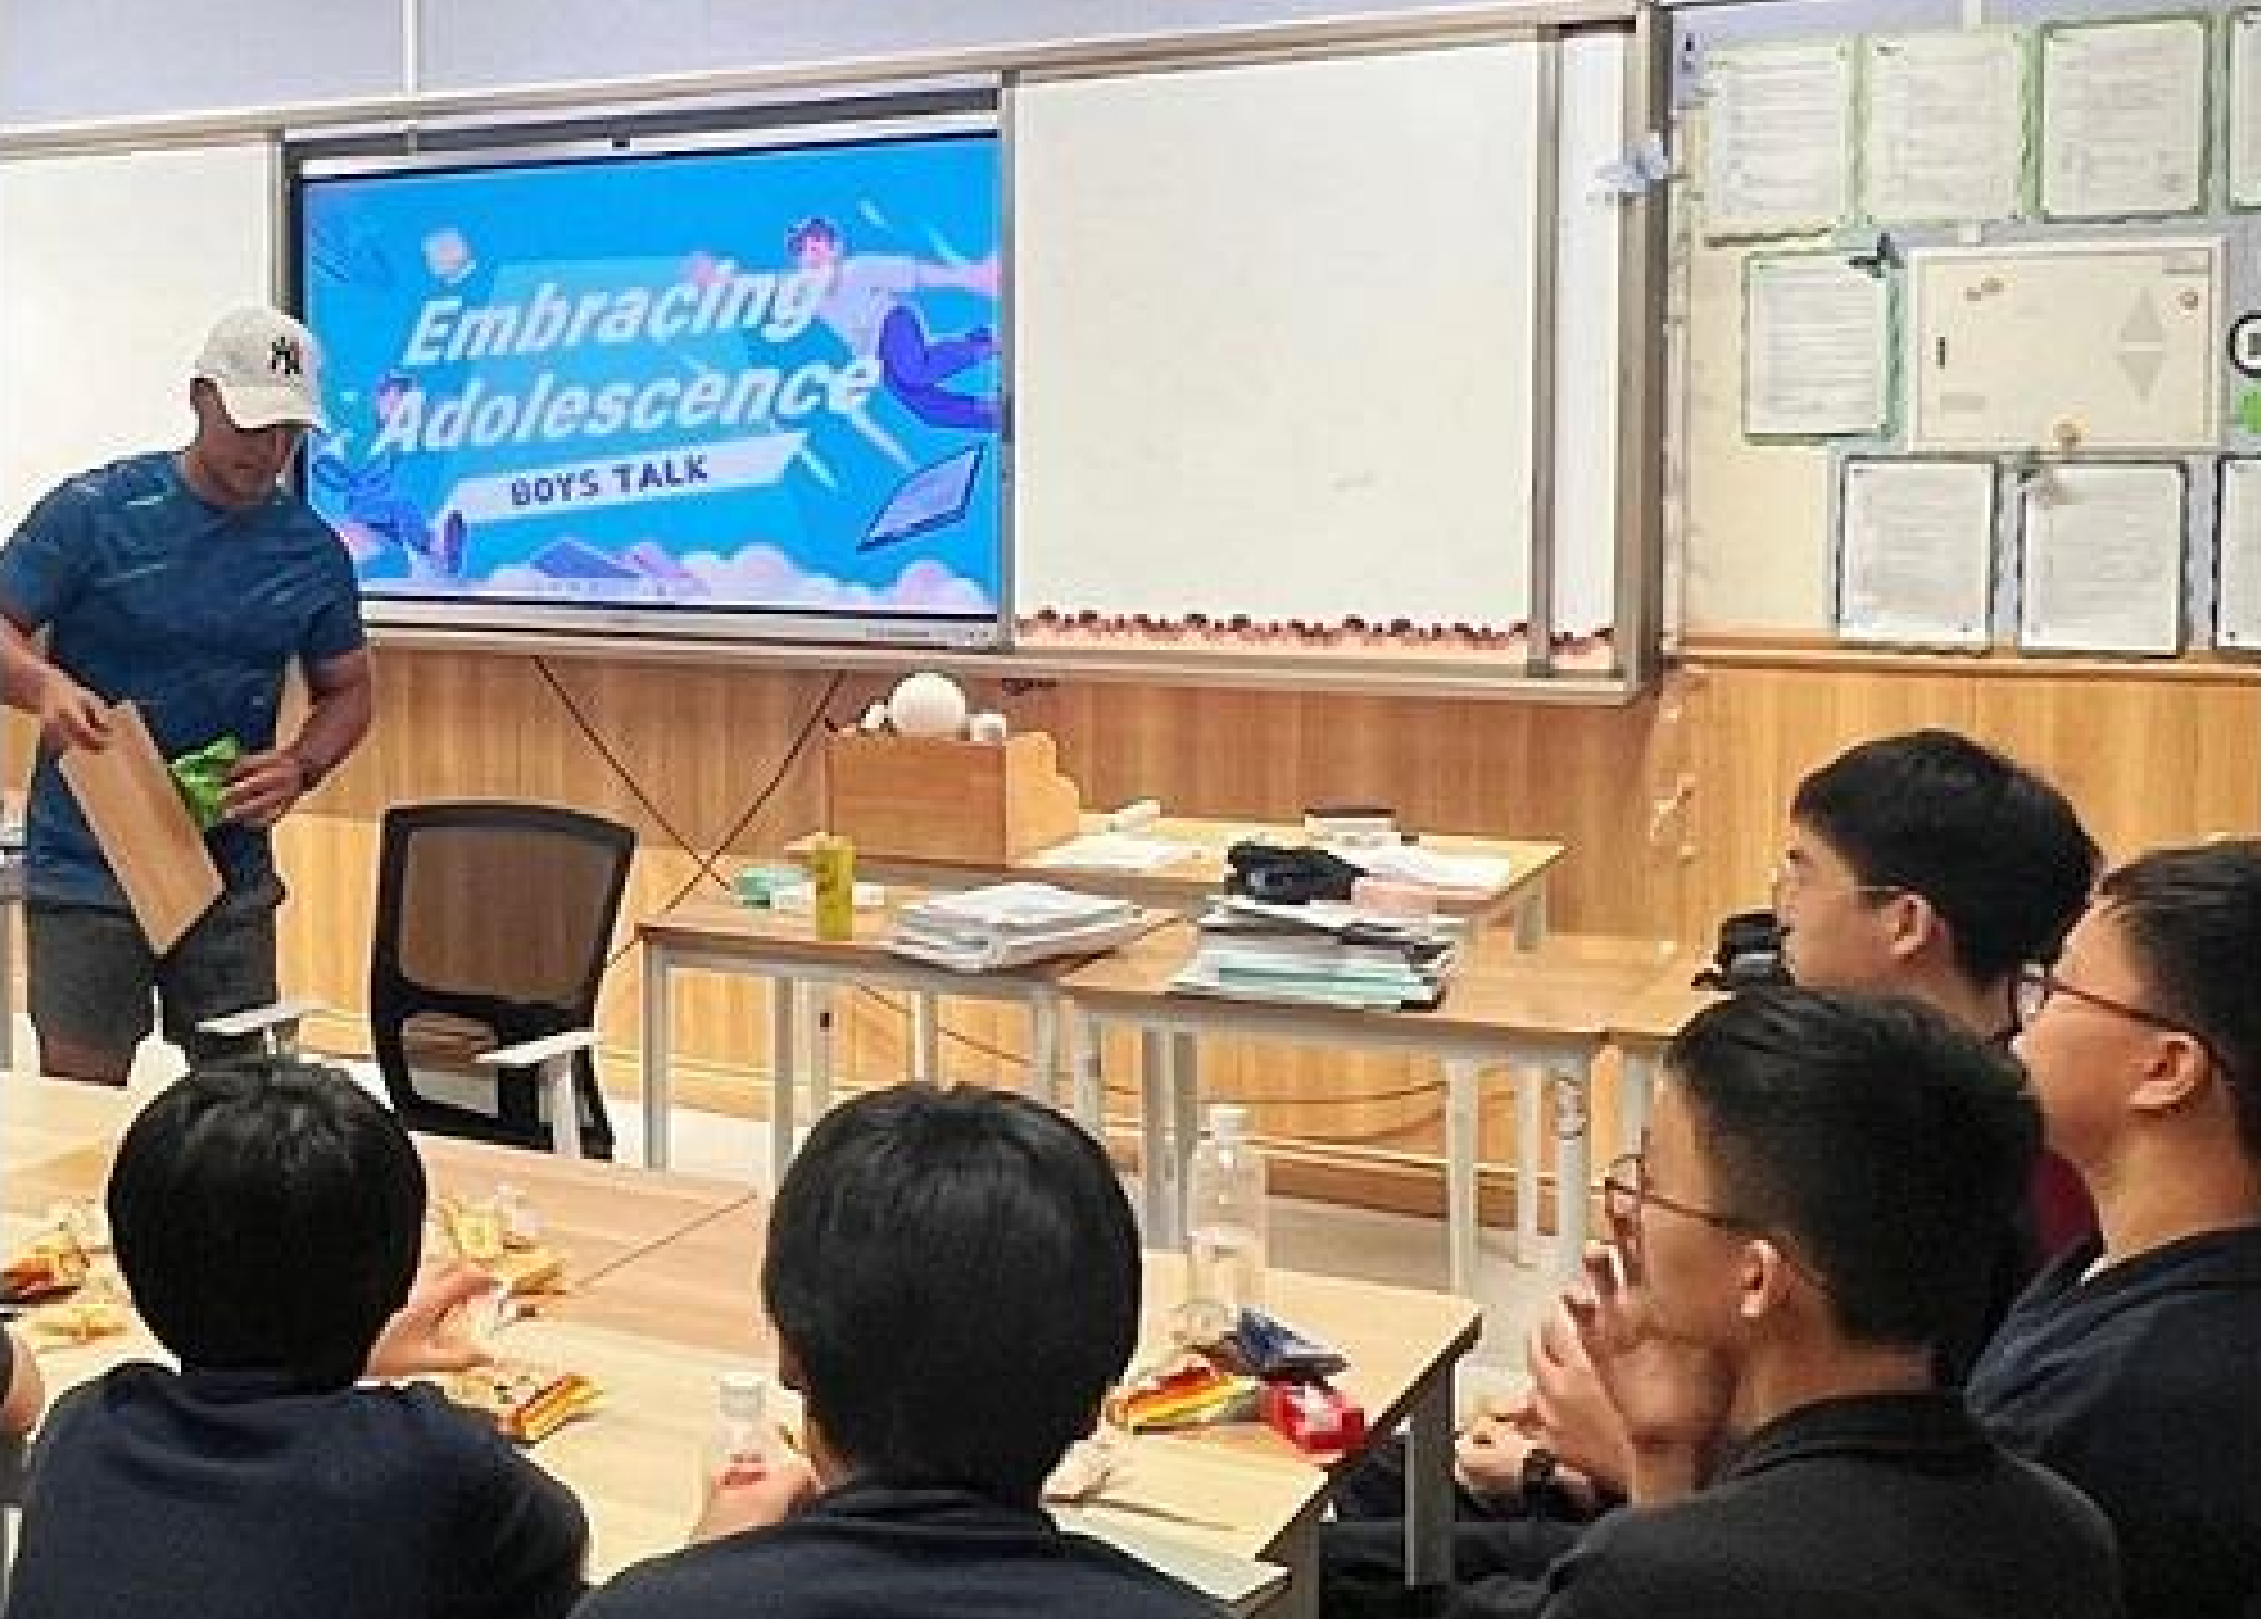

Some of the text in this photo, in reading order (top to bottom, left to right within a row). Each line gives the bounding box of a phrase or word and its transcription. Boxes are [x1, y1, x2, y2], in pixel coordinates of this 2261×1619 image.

[403, 259, 823, 367] Embracing
[370, 356, 880, 455] Adolescence
[511, 454, 708, 506] BOYS TALK
